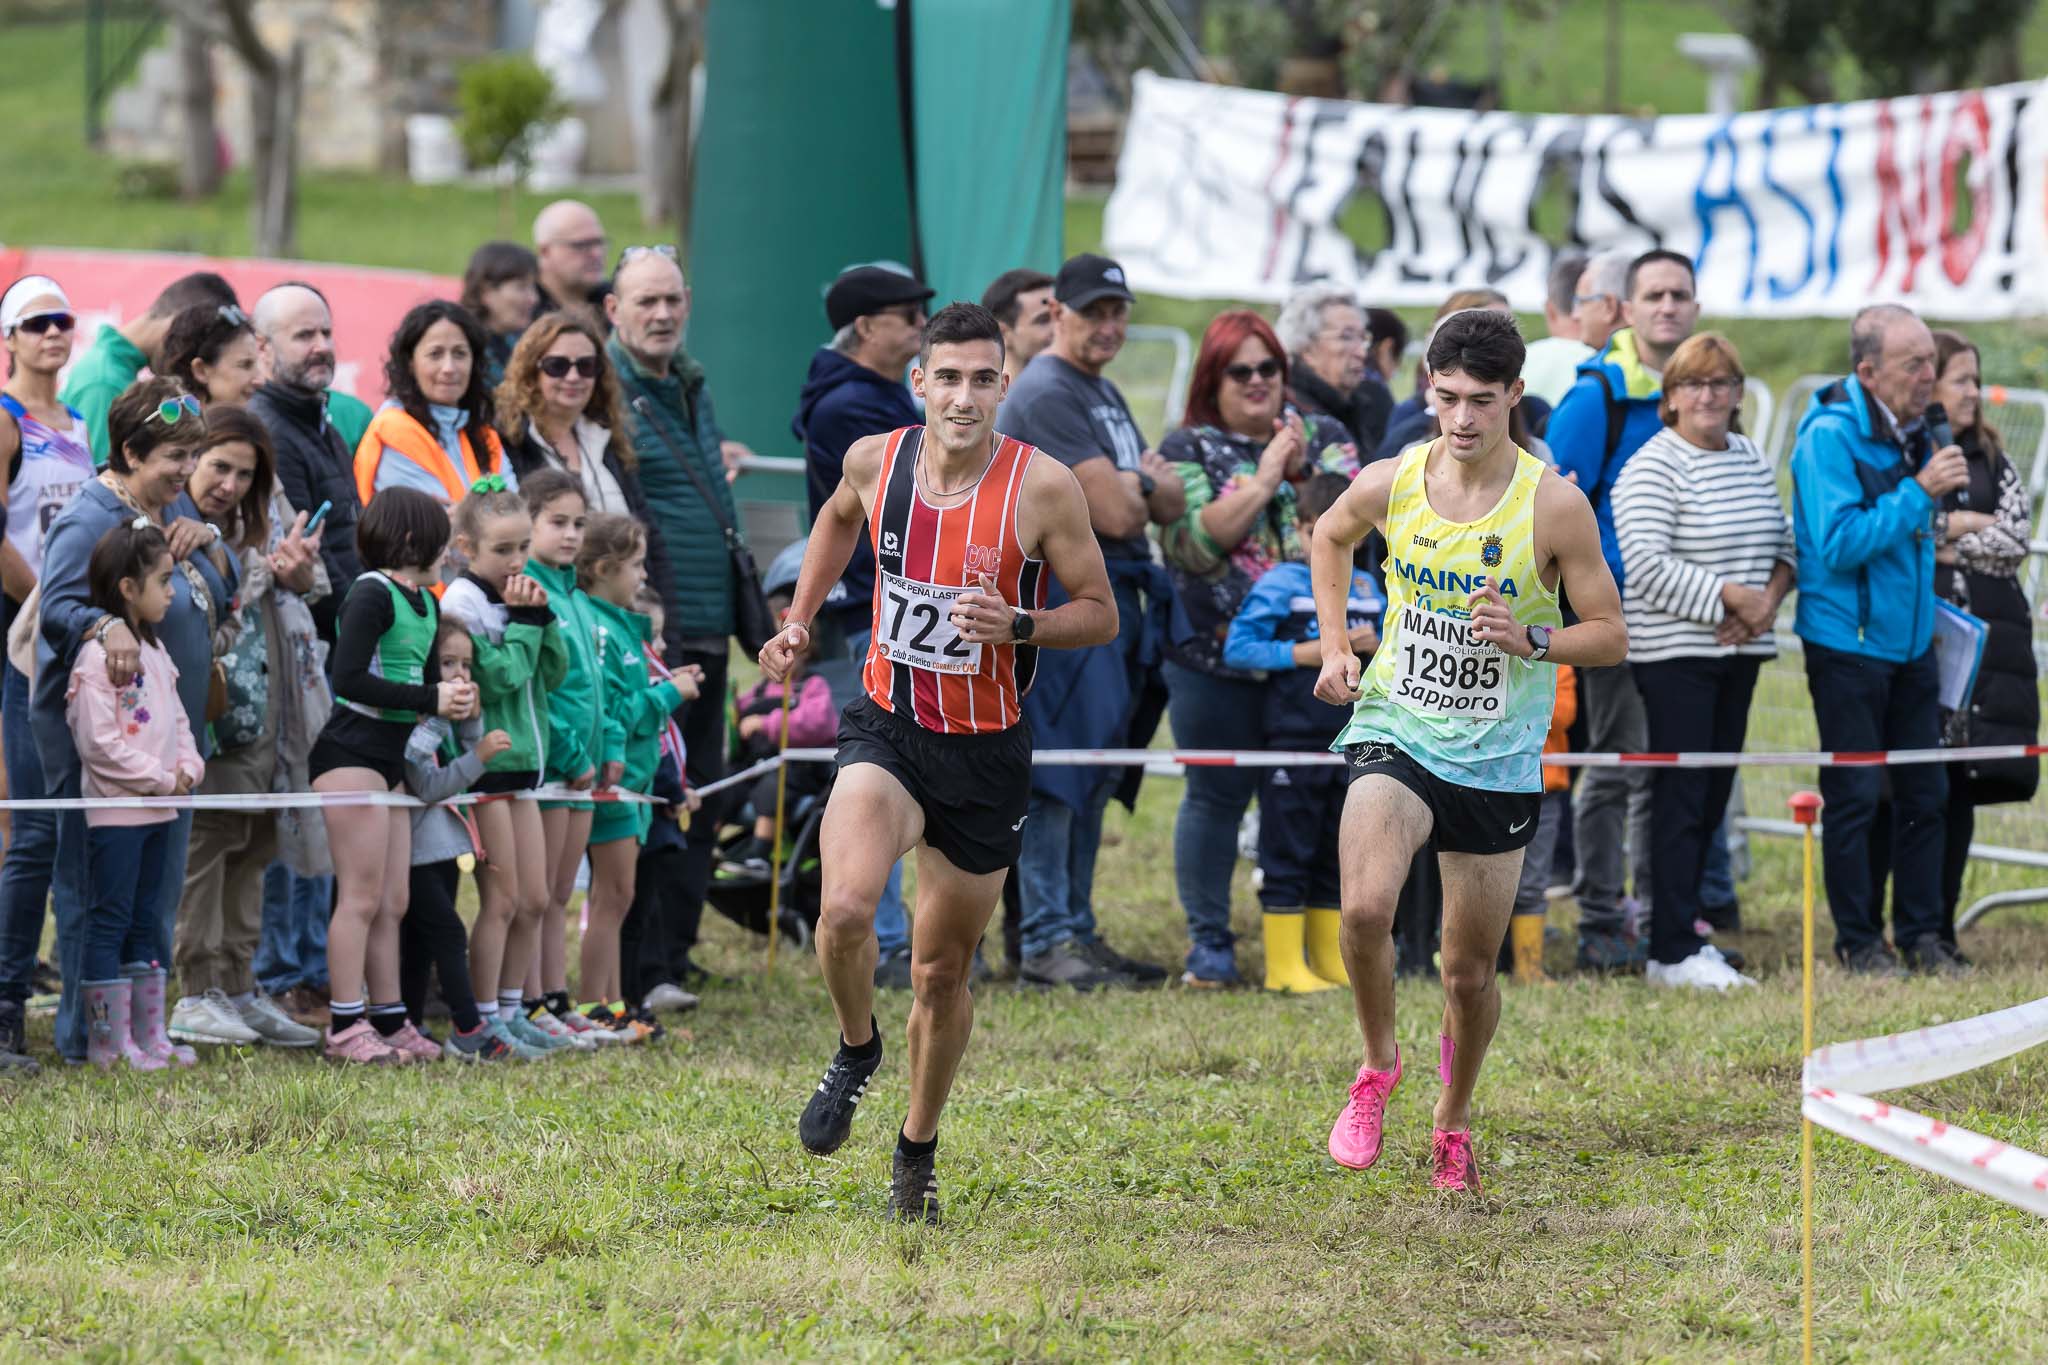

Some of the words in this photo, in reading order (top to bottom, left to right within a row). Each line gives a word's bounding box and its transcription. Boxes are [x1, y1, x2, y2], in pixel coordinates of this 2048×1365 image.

[1413, 534, 1438, 549] GOBIK
[887, 576, 907, 591] JOSÉ
[892, 649, 907, 660] club
[1448, 645, 1503, 656] POLIGRUAS
[1404, 643, 1501, 690] 12985
[1397, 678, 1499, 711] Sapporo
